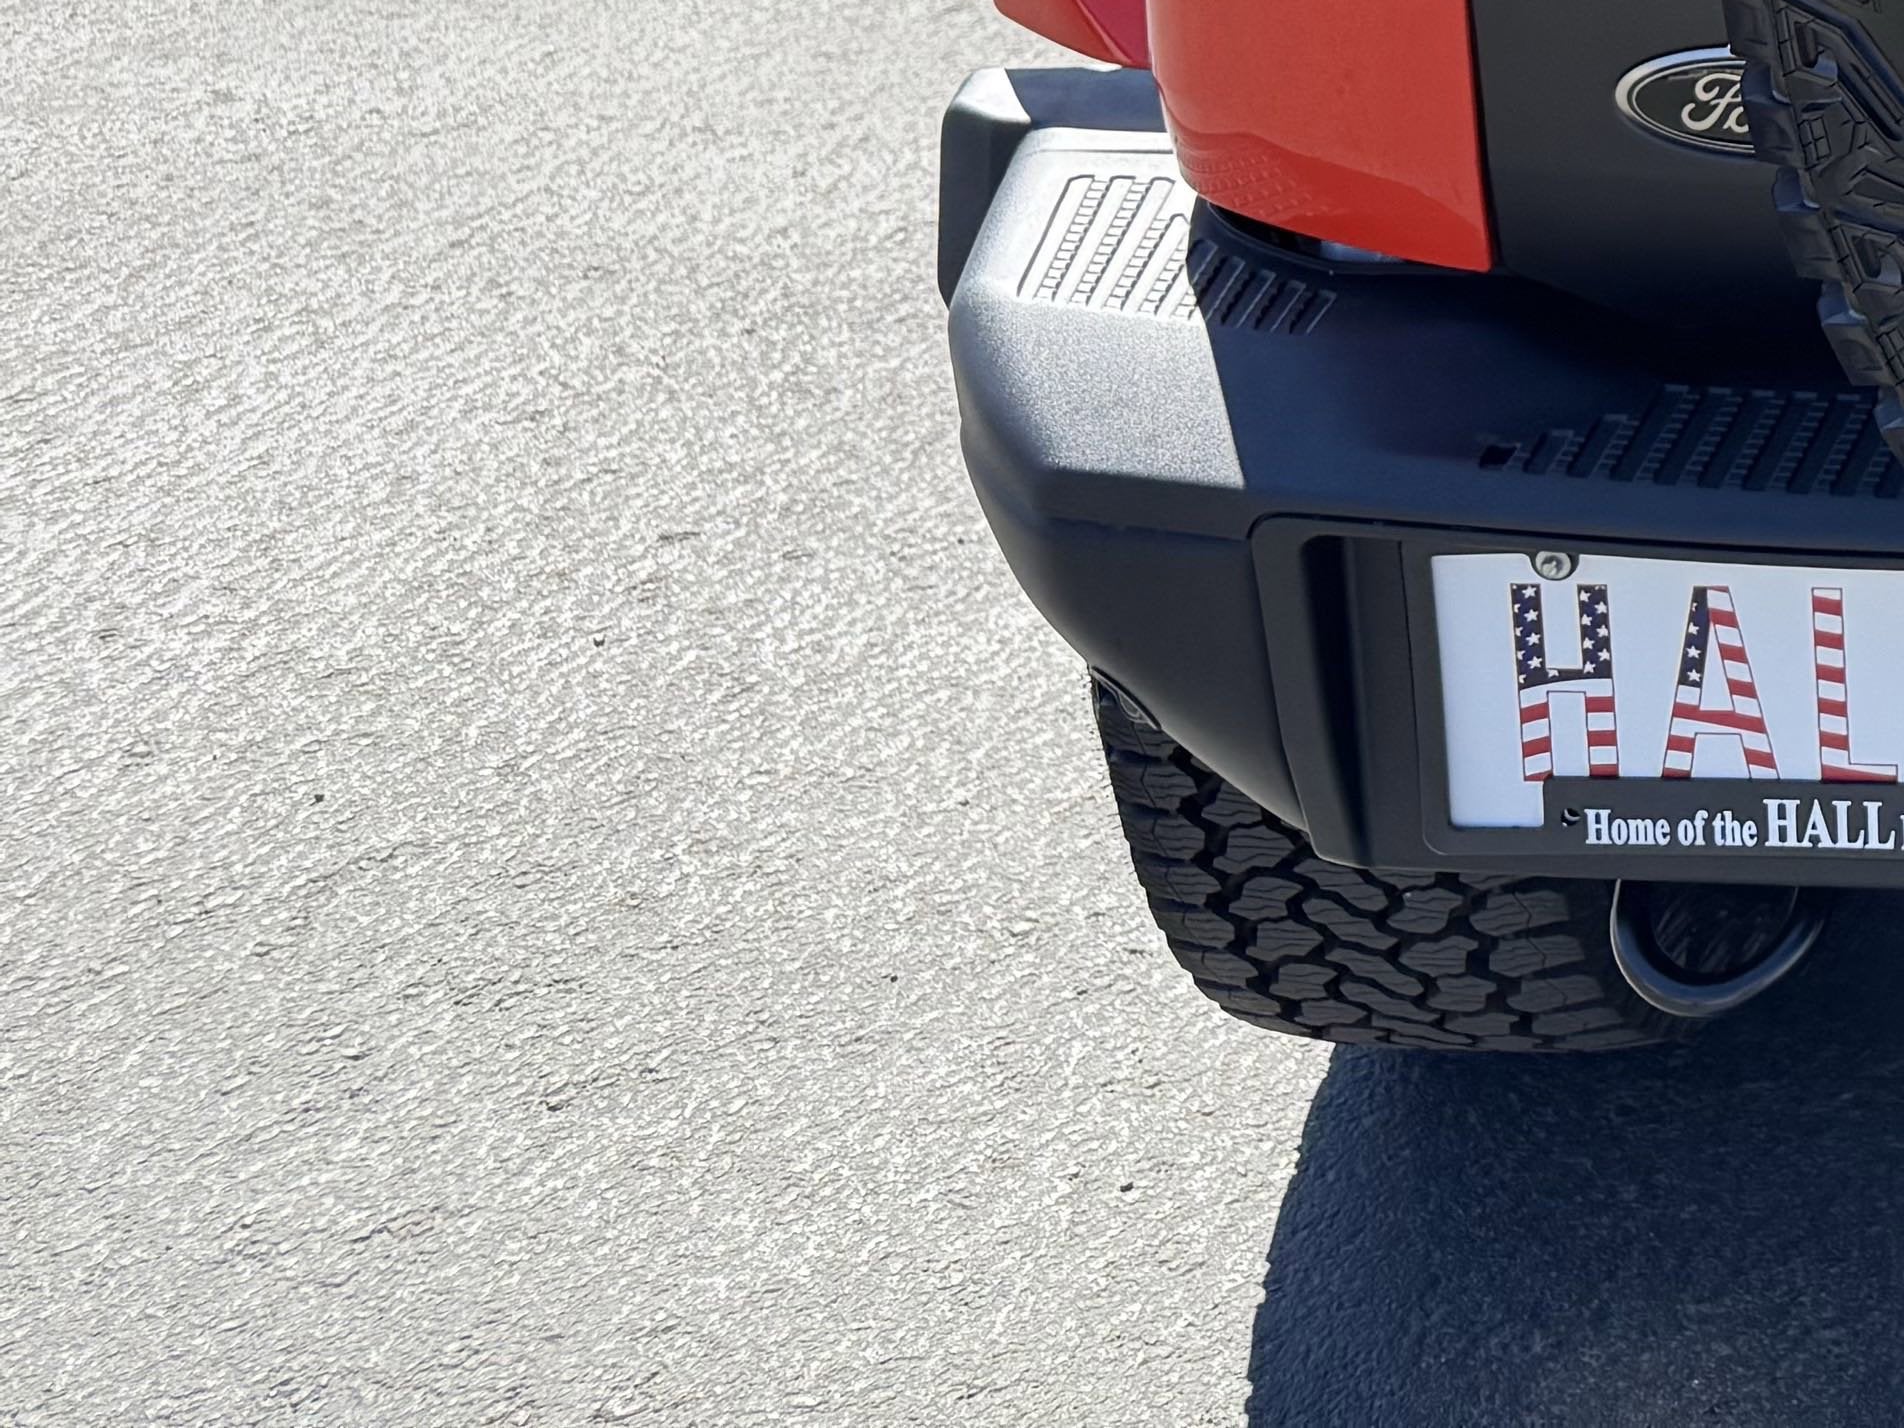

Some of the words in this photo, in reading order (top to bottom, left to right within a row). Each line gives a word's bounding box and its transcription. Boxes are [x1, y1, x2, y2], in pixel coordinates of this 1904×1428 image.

[1680, 72, 1749, 133] Fo
[1585, 808, 1673, 847] Home
[1676, 810, 1709, 847] of
[1711, 812, 1757, 848] the
[1762, 798, 1899, 852] HALL
